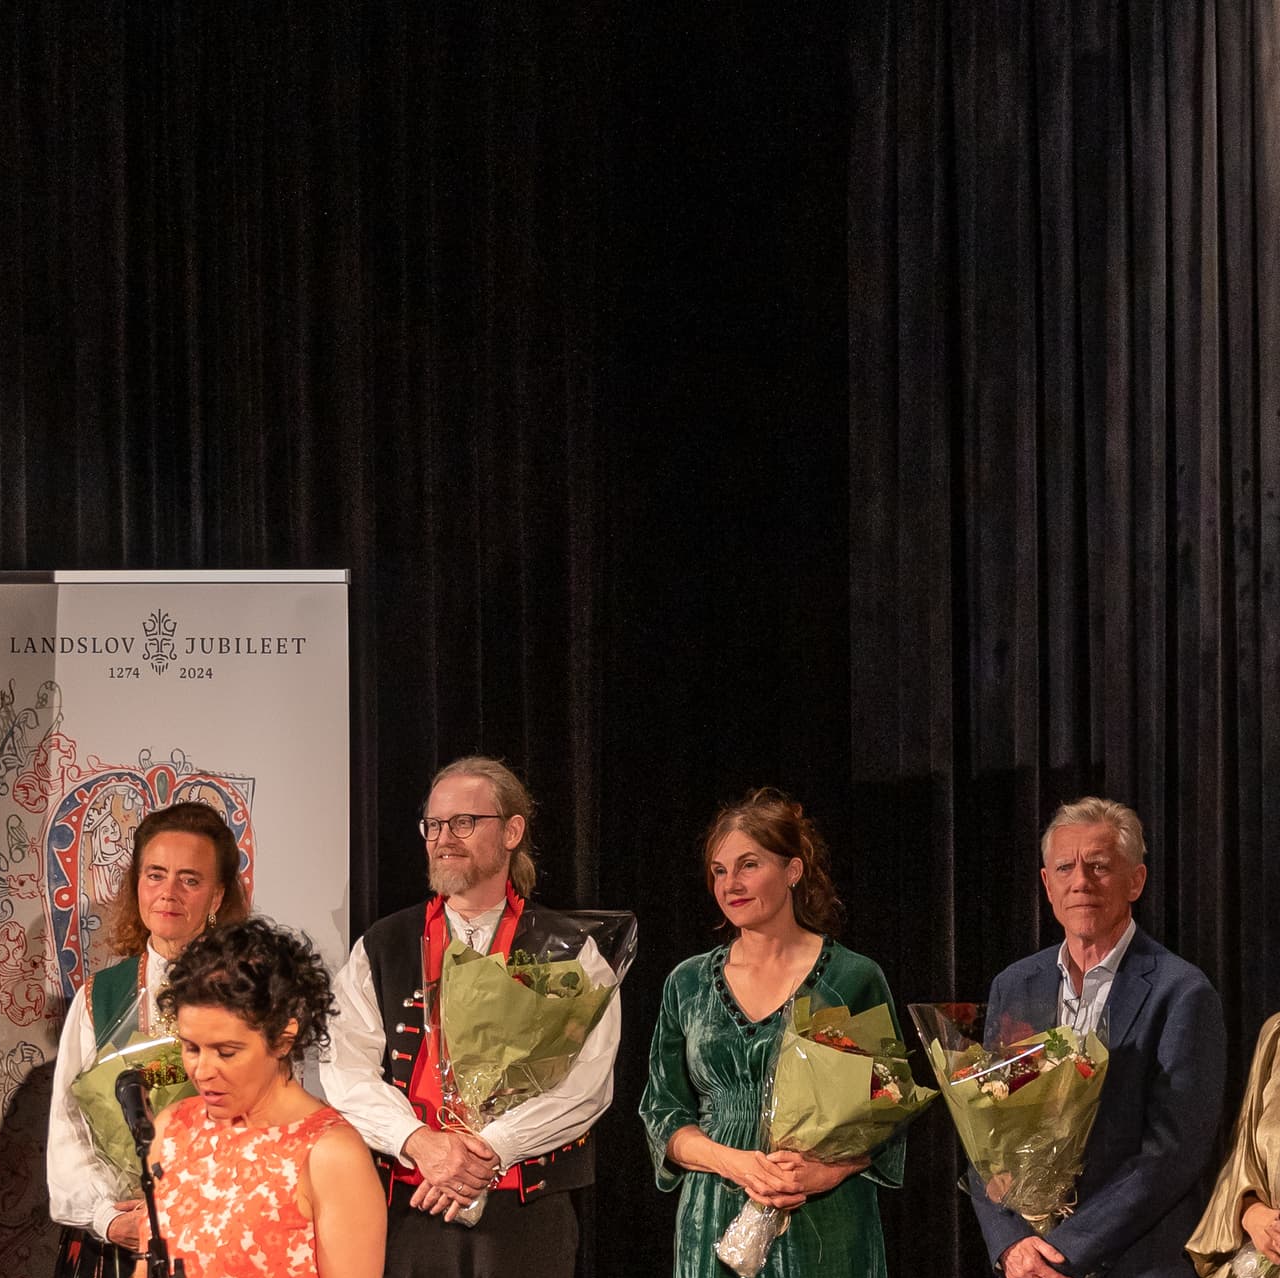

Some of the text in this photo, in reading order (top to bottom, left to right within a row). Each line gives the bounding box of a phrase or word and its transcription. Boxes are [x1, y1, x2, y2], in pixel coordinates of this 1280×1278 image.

[9, 636, 307, 655] LANDSLOV JUBILEET
[108, 666, 214, 680] 1274 2024
